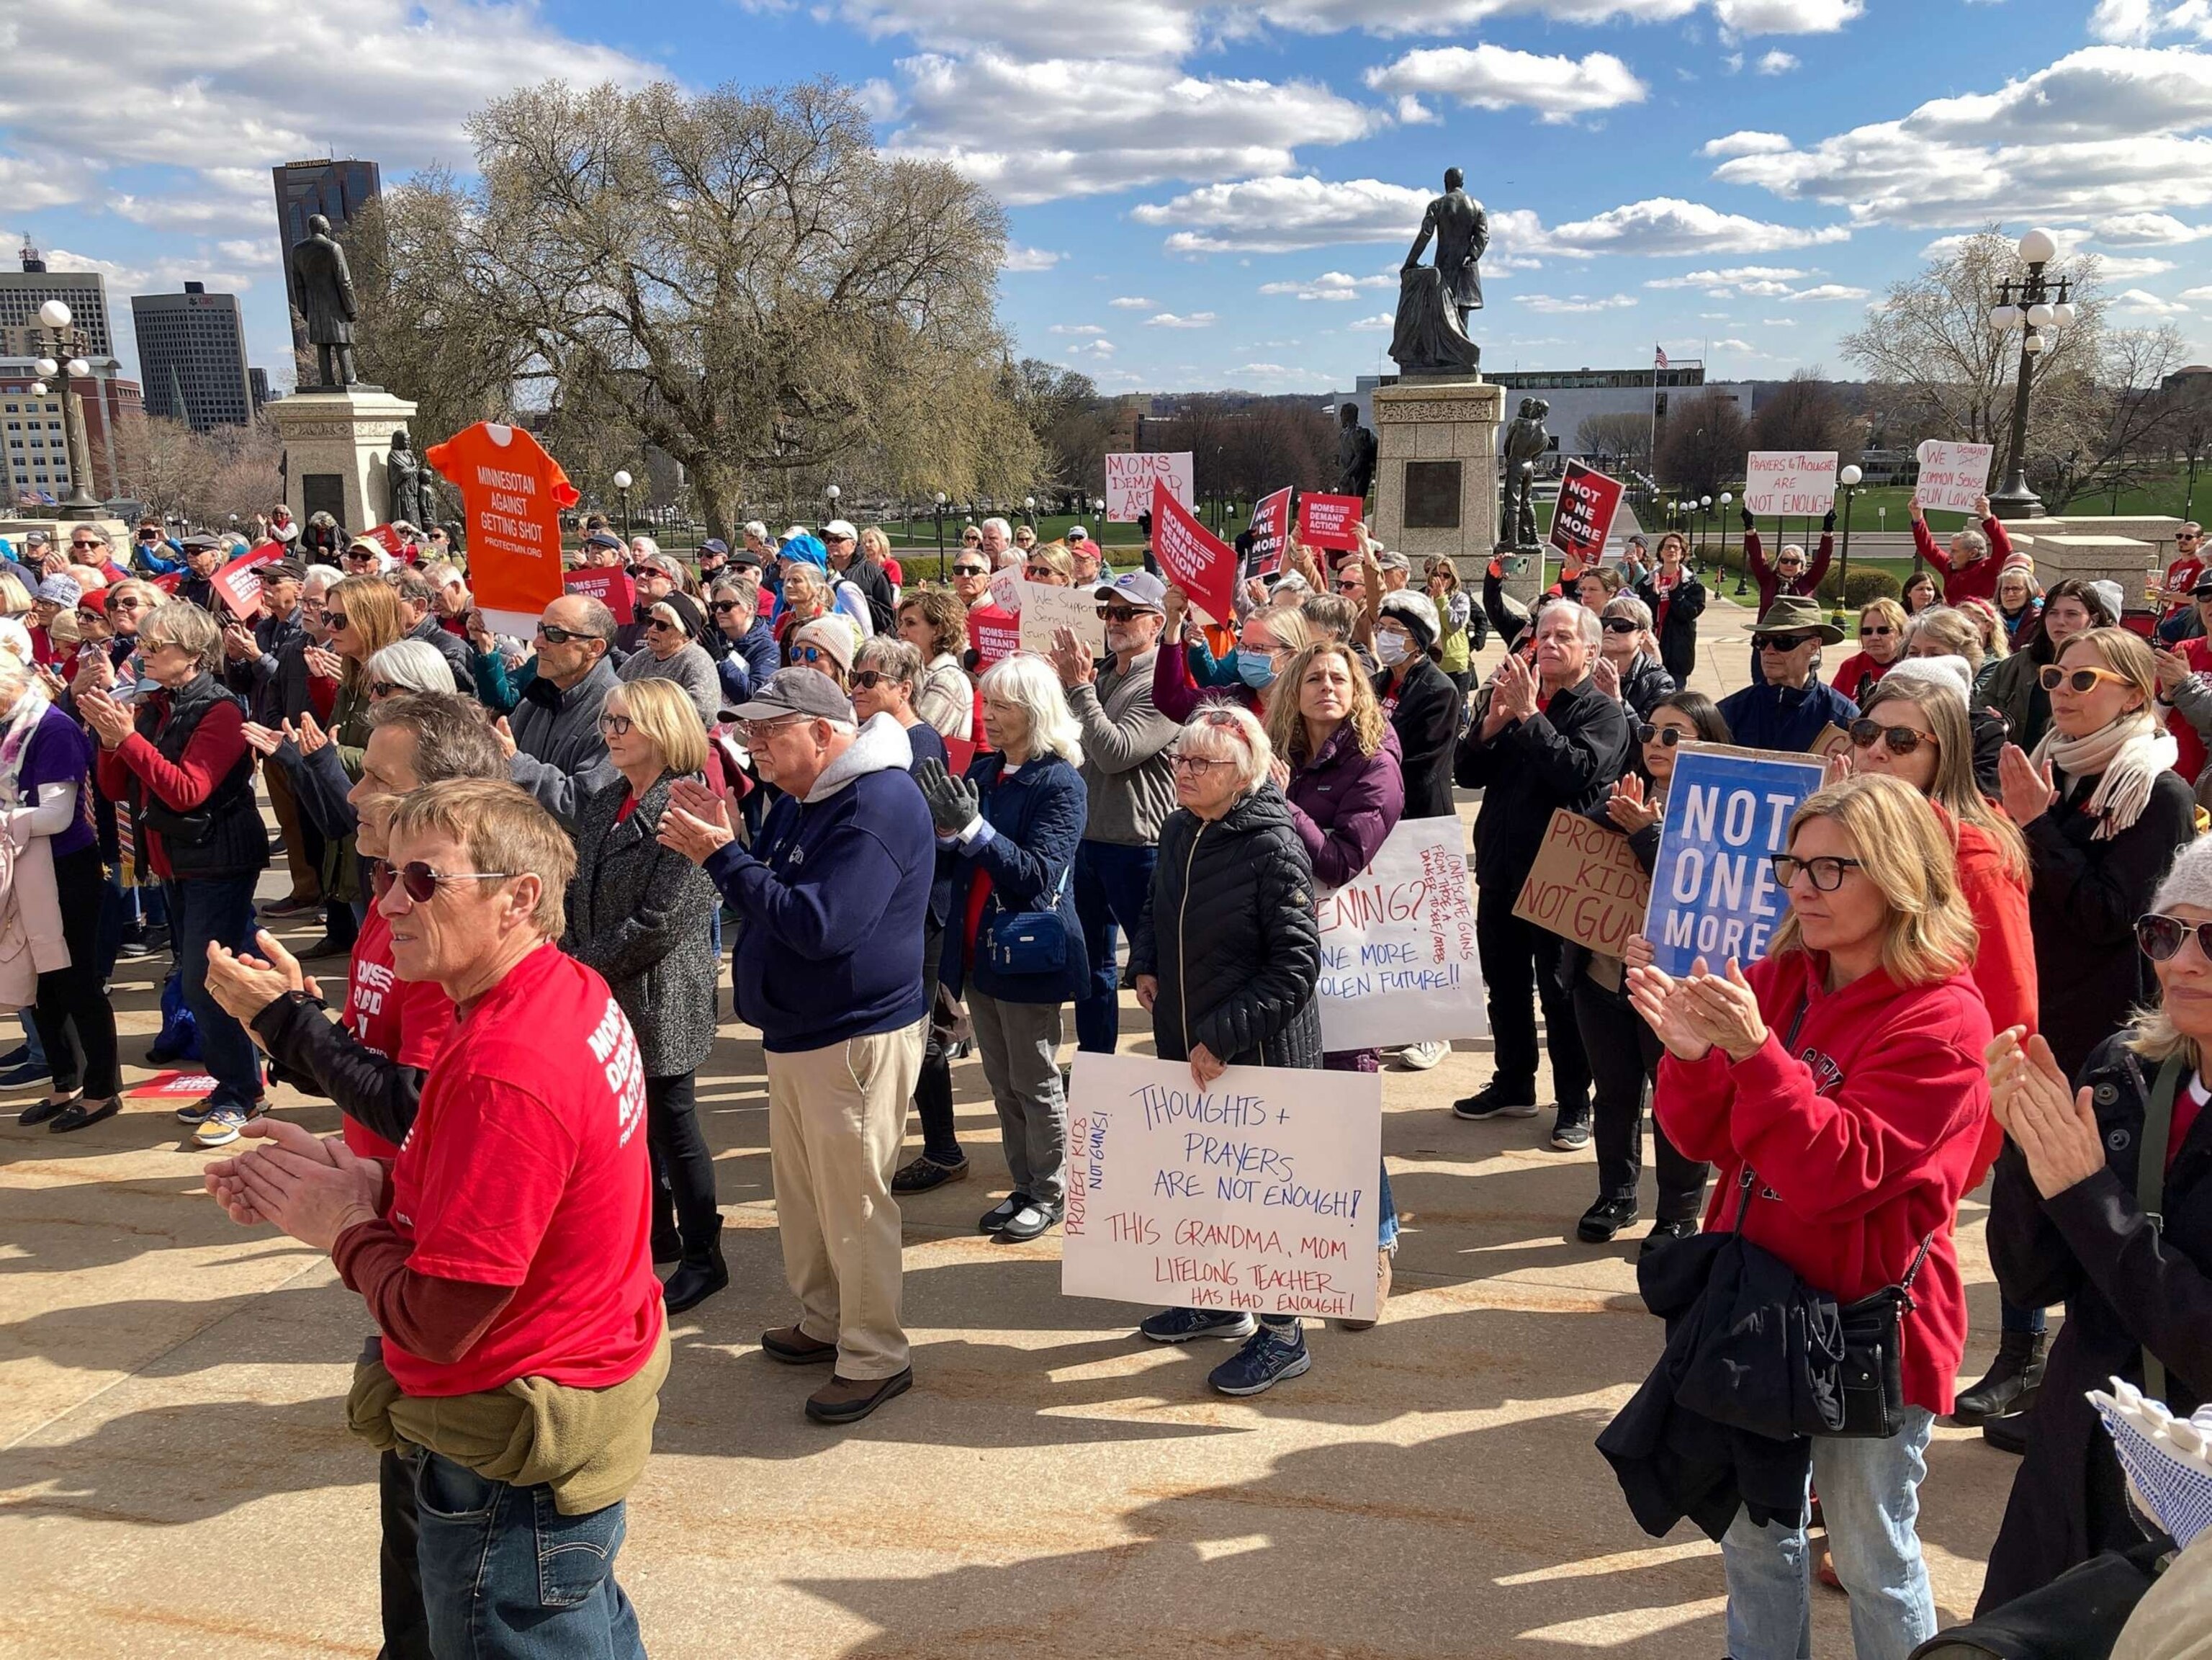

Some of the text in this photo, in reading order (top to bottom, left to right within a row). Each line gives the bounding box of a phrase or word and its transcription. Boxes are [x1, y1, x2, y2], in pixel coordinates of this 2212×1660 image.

[1108, 455, 1170, 475] MOMS
[1750, 454, 1786, 471] PRAYERS
[1926, 445, 1947, 465] WE
[477, 465, 535, 495] MINNESOTAN
[1112, 475, 1182, 490] DEMAD
[1568, 479, 1601, 503] NOT
[1773, 477, 1797, 489] ARE
[1920, 472, 1954, 485] COMMON
[491, 491, 527, 516] AGAINST
[1310, 503, 1335, 513] MOMS
[1565, 497, 1596, 521] ONE
[1748, 494, 1833, 513] NOT ENOUGH
[1917, 488, 1942, 503] GUN
[481, 511, 542, 543] GETTING SHOT
[1163, 503, 1193, 545] MOMS
[1255, 505, 1277, 522] NOT
[1309, 511, 1344, 523] DEMAND
[1310, 520, 1340, 531] ACTION
[1560, 512, 1601, 542] MORE
[485, 536, 542, 558] PROTECTMN.ORG
[1161, 518, 1206, 571] DEMAND
[1161, 532, 1197, 579] ACTION
[1252, 535, 1282, 553] MORE
[1031, 586, 1053, 605] We
[979, 626, 1004, 638] MOMS
[1033, 606, 1086, 629] Sensible
[979, 636, 1016, 650] DEMAND
[1681, 784, 1795, 851] NOT
[1550, 812, 1647, 874] PROTE
[1420, 849, 1437, 894] DANGER
[1431, 844, 1447, 875] FROM
[1438, 878, 1452, 911] THOSE
[1575, 858, 1651, 909] KIDS
[1672, 847, 1776, 917] ONE
[1314, 880, 1427, 933] ENING?
[1444, 853, 1474, 961] CONFISCATE GUNS
[1516, 877, 1645, 953] NOT GUN
[1663, 909, 1771, 961] MORE
[1321, 942, 1419, 970] NE MORE
[1318, 972, 1370, 999] OLEN
[1130, 1084, 1290, 1131] THOUGHTS +
[1088, 1111, 1113, 1190] NOT GUNS!
[1184, 1132, 1294, 1183] PRAYERS
[1066, 1117, 1087, 1236] PROTECT KIDS
[1154, 1170, 1362, 1228] ARE NOT ENOUGH!
[1104, 1211, 1161, 1245] THIS
[1300, 1237, 1347, 1261] MOM
[1156, 1257, 1346, 1294] LIFELONG TEACHER
[1192, 1287, 1355, 1317] HAS HAD ENOUGH!
